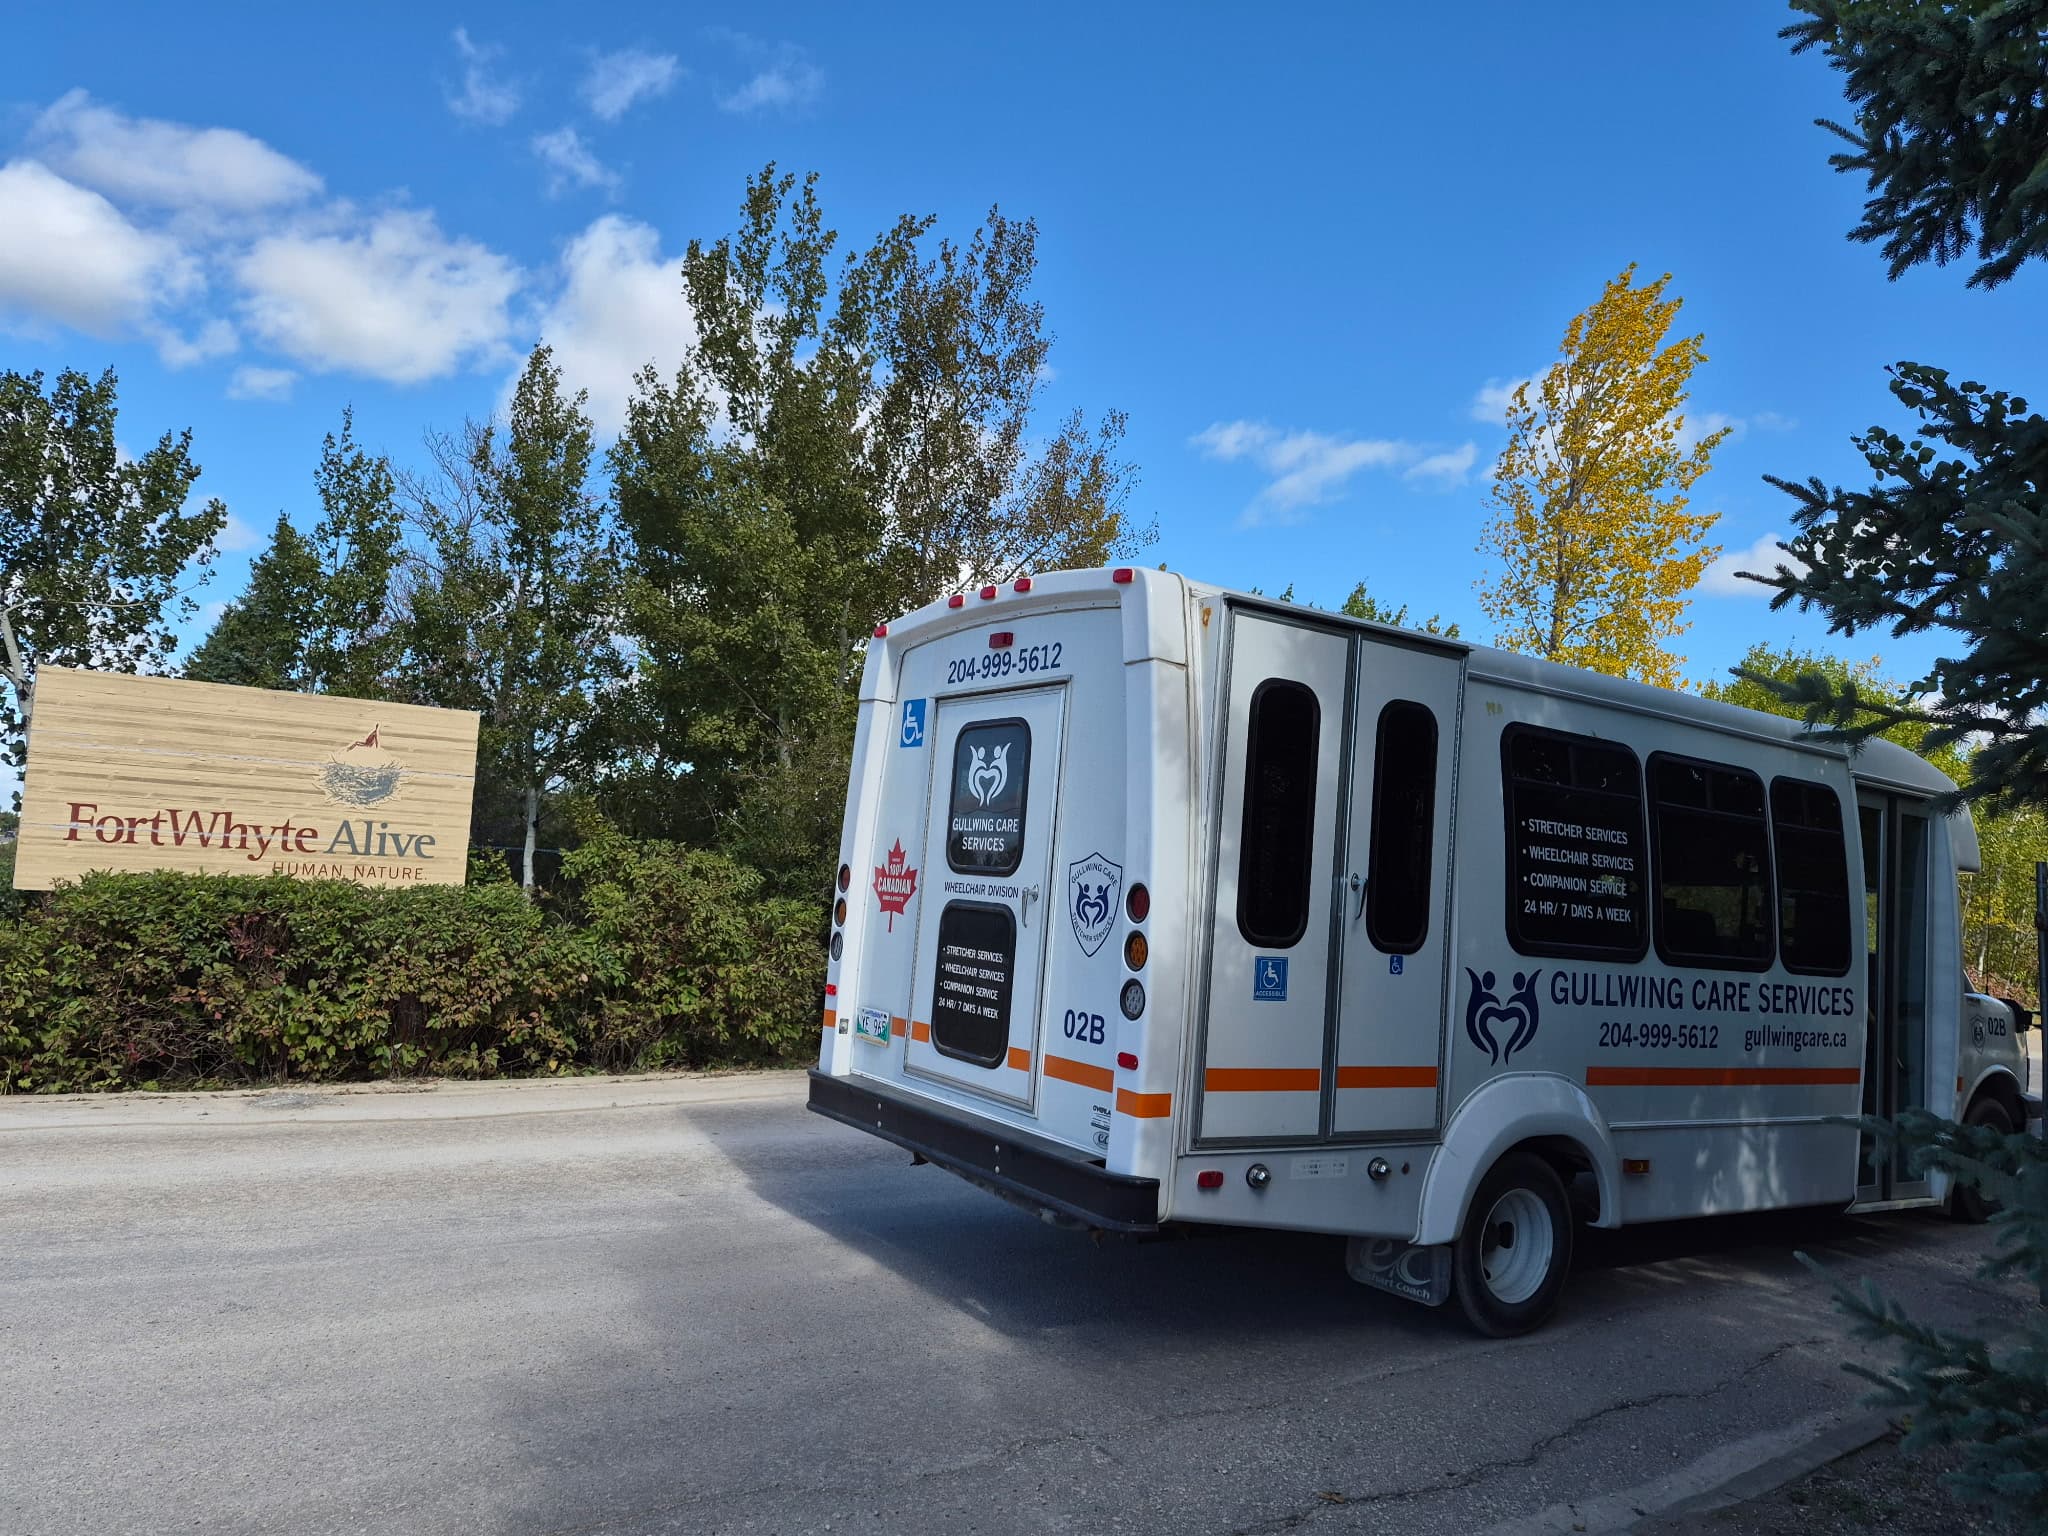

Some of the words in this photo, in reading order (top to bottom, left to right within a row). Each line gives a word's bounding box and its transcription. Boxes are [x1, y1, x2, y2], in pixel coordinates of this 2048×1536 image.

[947, 642, 1062, 684] 204-999-5612
[62, 802, 319, 862] FortWhyte
[323, 820, 436, 859] Alive
[952, 818, 994, 832] GULLWING
[996, 818, 1019, 832] CARE
[1528, 818, 1583, 839] STRETCHER
[1585, 827, 1628, 845] SERVICES
[962, 836, 1005, 852] SERVICES
[1529, 845, 1589, 866] WHEELCHAIR
[1592, 853, 1634, 872] SERVICES
[353, 866, 428, 880] NATURE.
[1072, 862, 1102, 884] GULLWING
[1102, 867, 1118, 887] CARE
[877, 877, 912, 895] CANADIAN
[944, 881, 986, 897] WHEELCHAIR
[987, 884, 1019, 899] DIVISION
[1530, 872, 1587, 892] COMPANION
[1590, 879, 1628, 897] SERVICE
[1524, 899, 1537, 914] 24
[1539, 901, 1558, 916] HR/
[1561, 903, 1568, 917] 7
[1571, 903, 1594, 920] DAYS
[1596, 907, 1604, 920] A
[1605, 907, 1632, 923] WEEK
[946, 945, 976, 960] STRETCHER
[977, 949, 1004, 963] SERVICES
[945, 962, 978, 978] WHEELCHAIR
[978, 968, 1005, 983] SERVICES
[943, 980, 975, 996] COMPANION
[975, 986, 999, 1001] SERVICE
[1550, 971, 1684, 1010] GULLWING
[1692, 979, 1751, 1013] CARE
[1758, 983, 1855, 1017] SERVICES
[938, 997, 946, 1008] 24
[946, 998, 957, 1010] HR/
[957, 1001, 962, 1011] 7
[962, 1002, 976, 1015] DAYS
[976, 1005, 982, 1016] A
[982, 1006, 999, 1019] WEEK
[1063, 1009, 1105, 1045] 02B
[1598, 1022, 1719, 1049] 204-999-5612
[1744, 1024, 1847, 1052] gullwingcare.ca
[1987, 1016, 2006, 1036] 02B
[1395, 1280, 1431, 1300] coach
